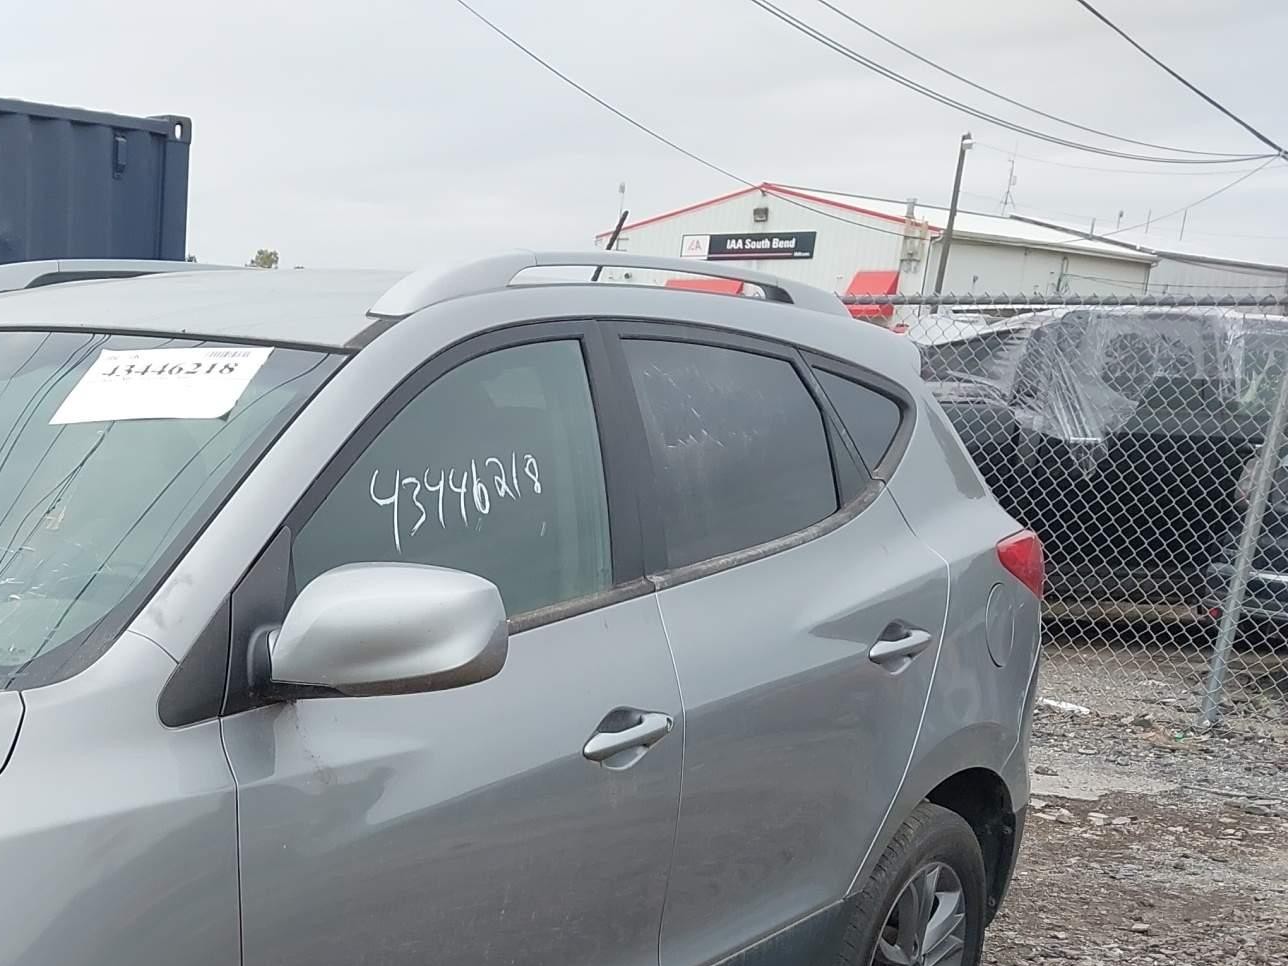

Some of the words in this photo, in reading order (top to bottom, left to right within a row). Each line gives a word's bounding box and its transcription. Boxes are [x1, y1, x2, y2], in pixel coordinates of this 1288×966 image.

[726, 239, 744, 249] IAA
[745, 238, 770, 249] South
[772, 237, 796, 248] Bend
[101, 361, 239, 378] 43446218
[369, 450, 543, 555] 43446218
